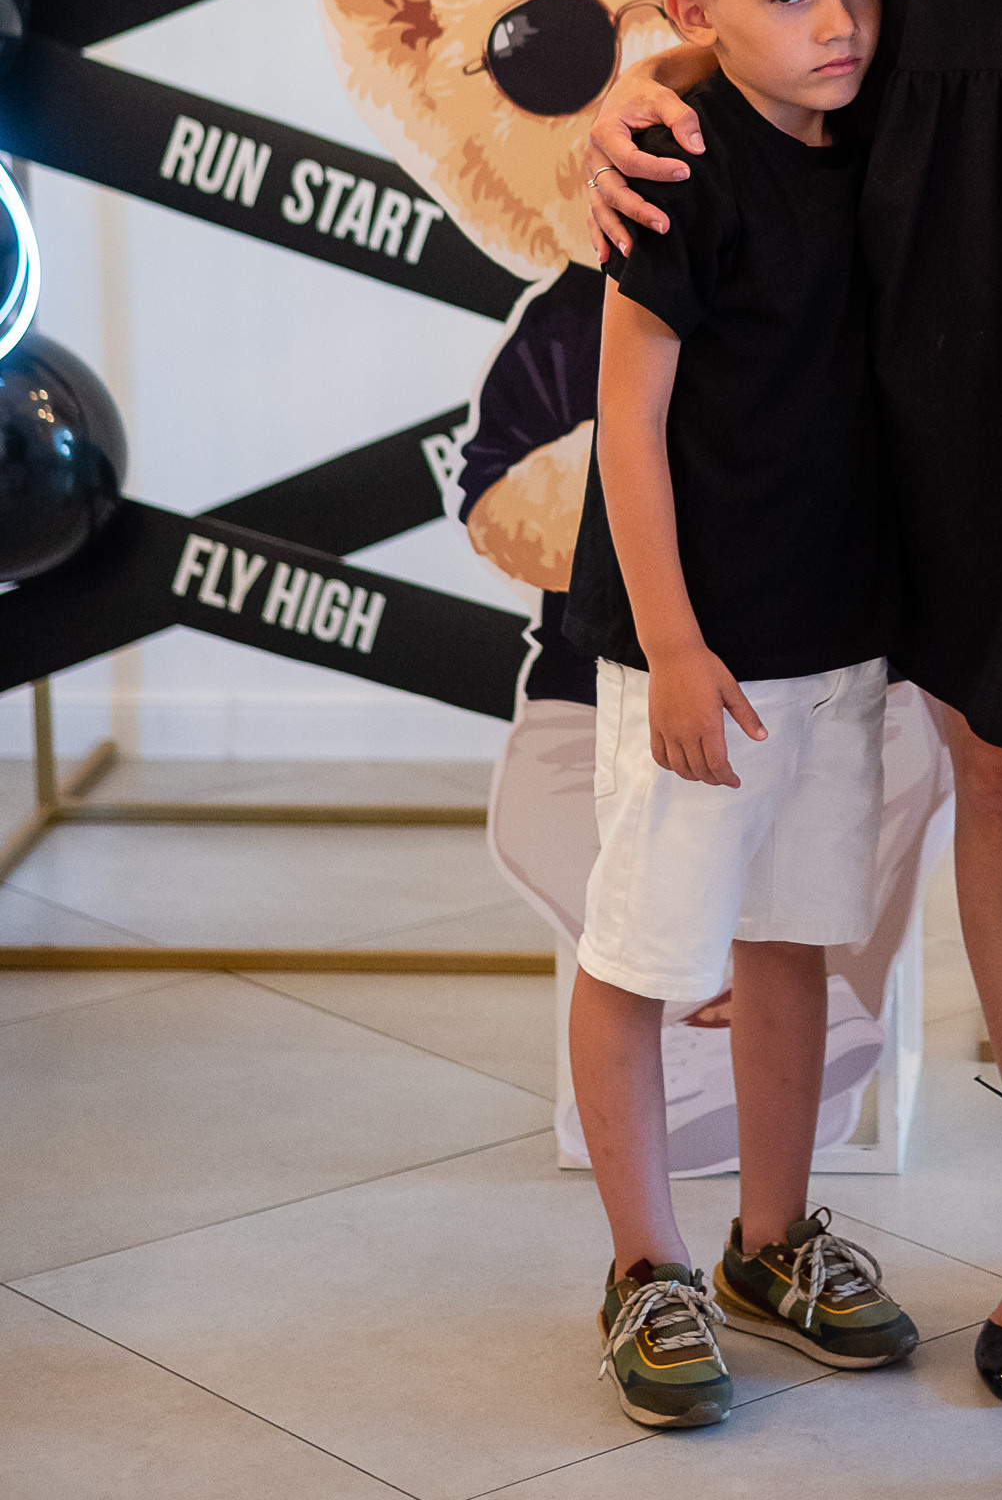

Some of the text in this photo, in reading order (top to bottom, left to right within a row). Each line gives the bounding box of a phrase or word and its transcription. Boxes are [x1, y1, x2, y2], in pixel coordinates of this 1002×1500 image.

[160, 114, 445, 266] RUN START
[172, 533, 387, 654] FLY HIGH
